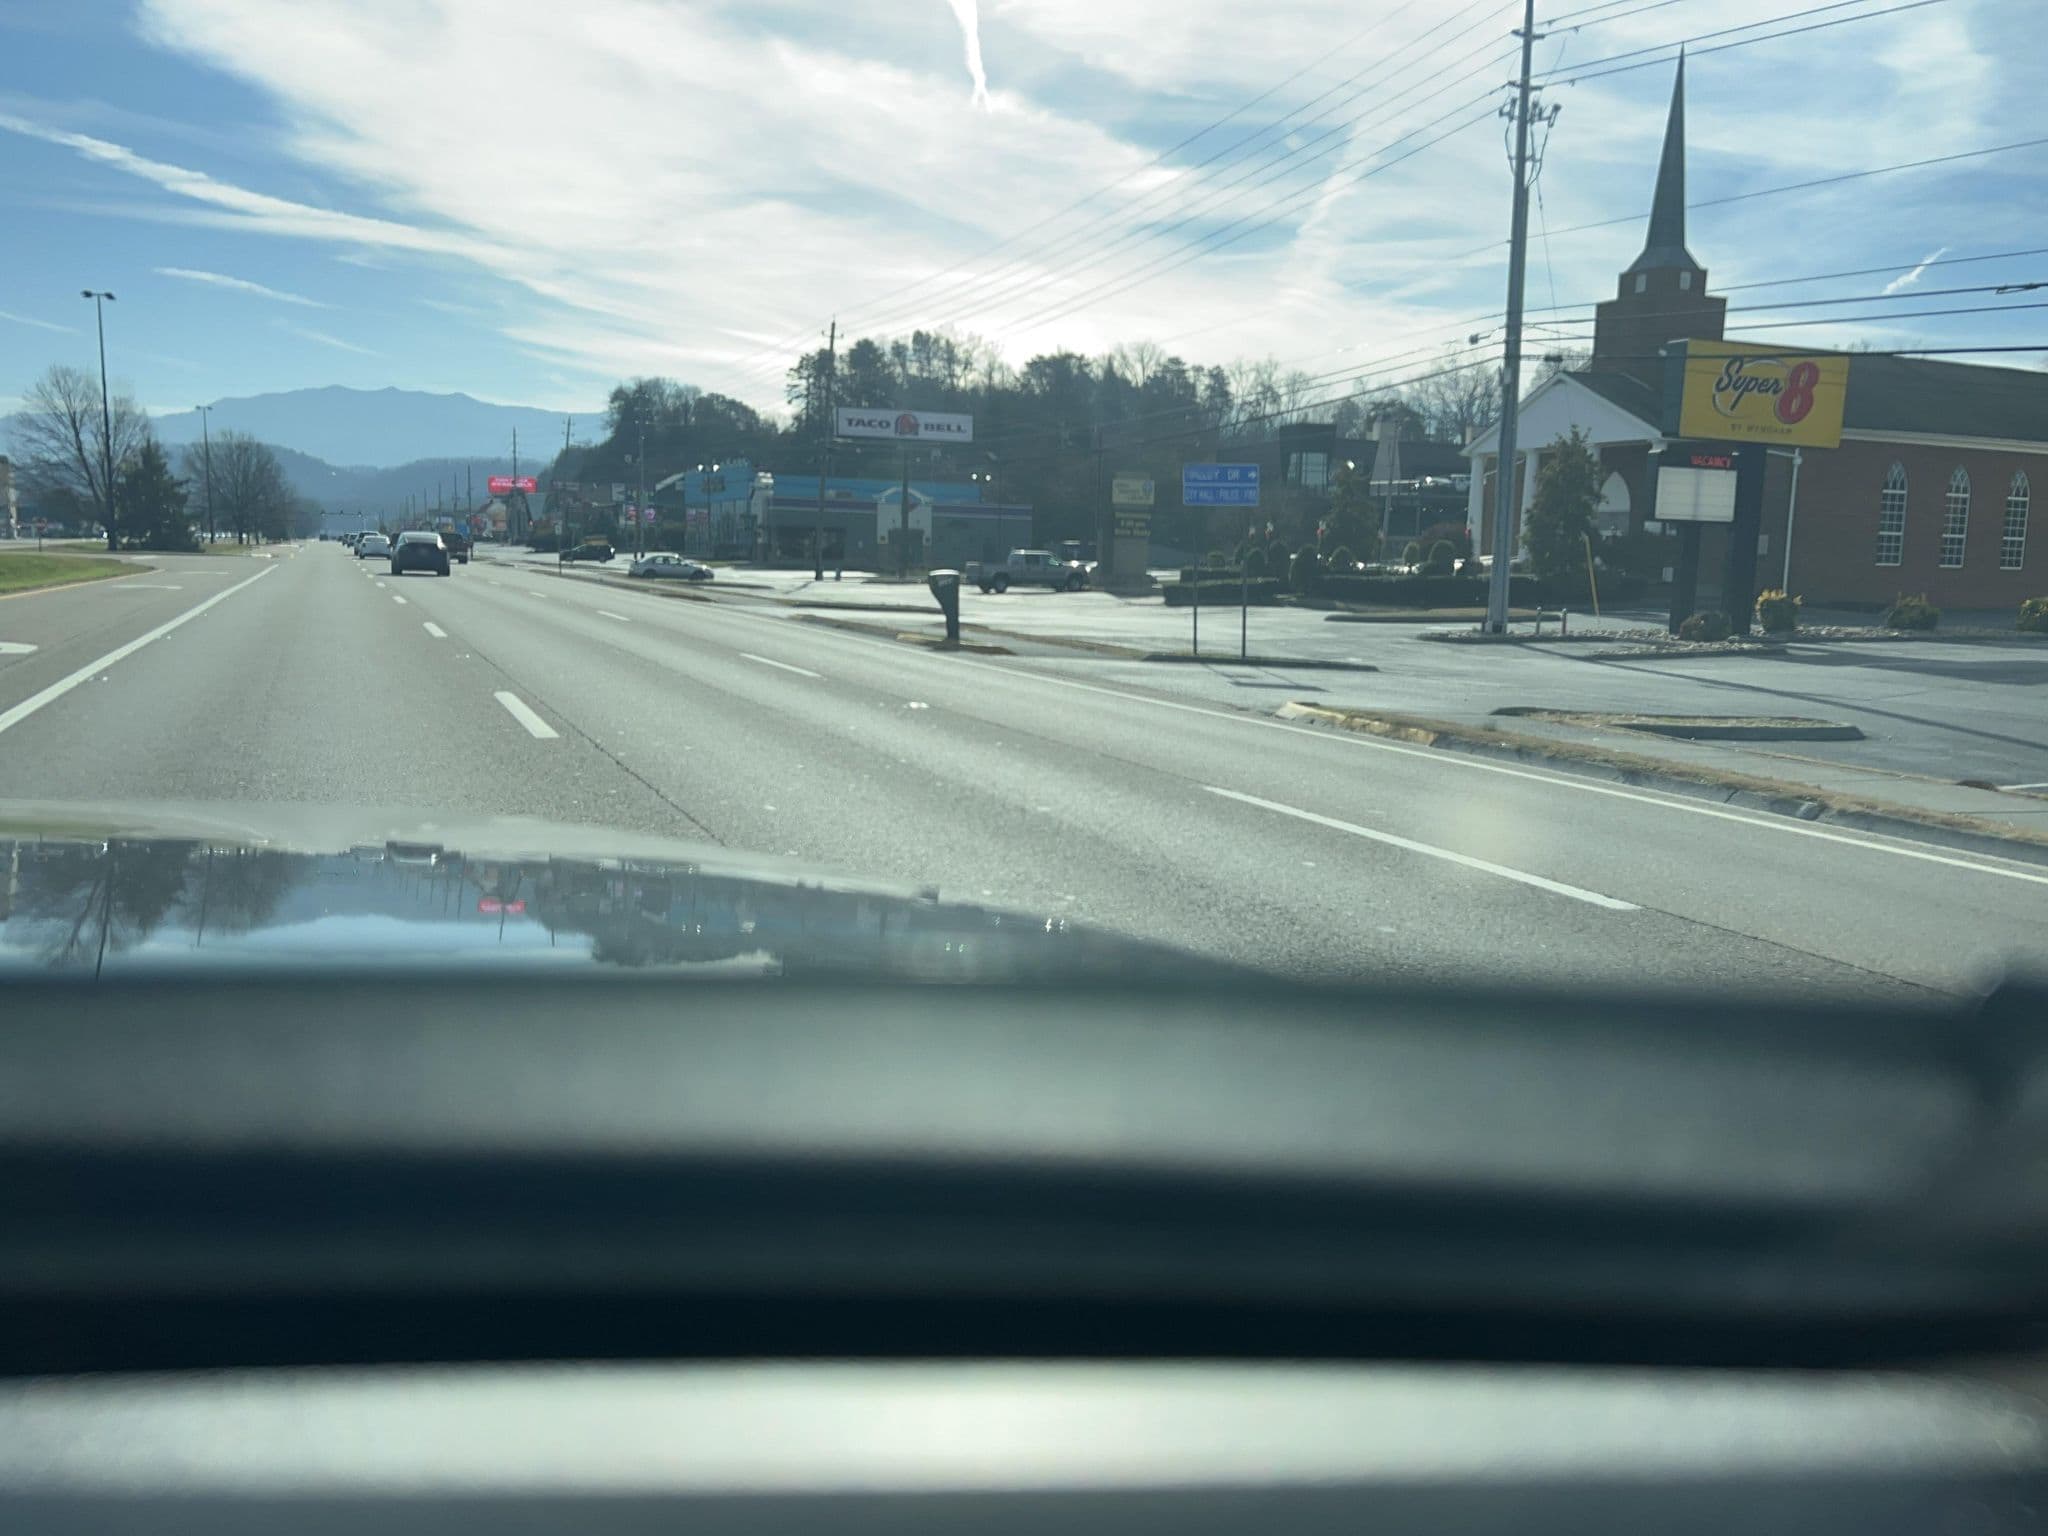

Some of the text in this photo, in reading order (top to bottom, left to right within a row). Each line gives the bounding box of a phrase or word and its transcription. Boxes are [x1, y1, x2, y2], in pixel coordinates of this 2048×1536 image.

[1714, 355, 1820, 424] Super 8
[845, 416, 967, 433] TACO BELL
[1691, 455, 1731, 468] VACANCY
